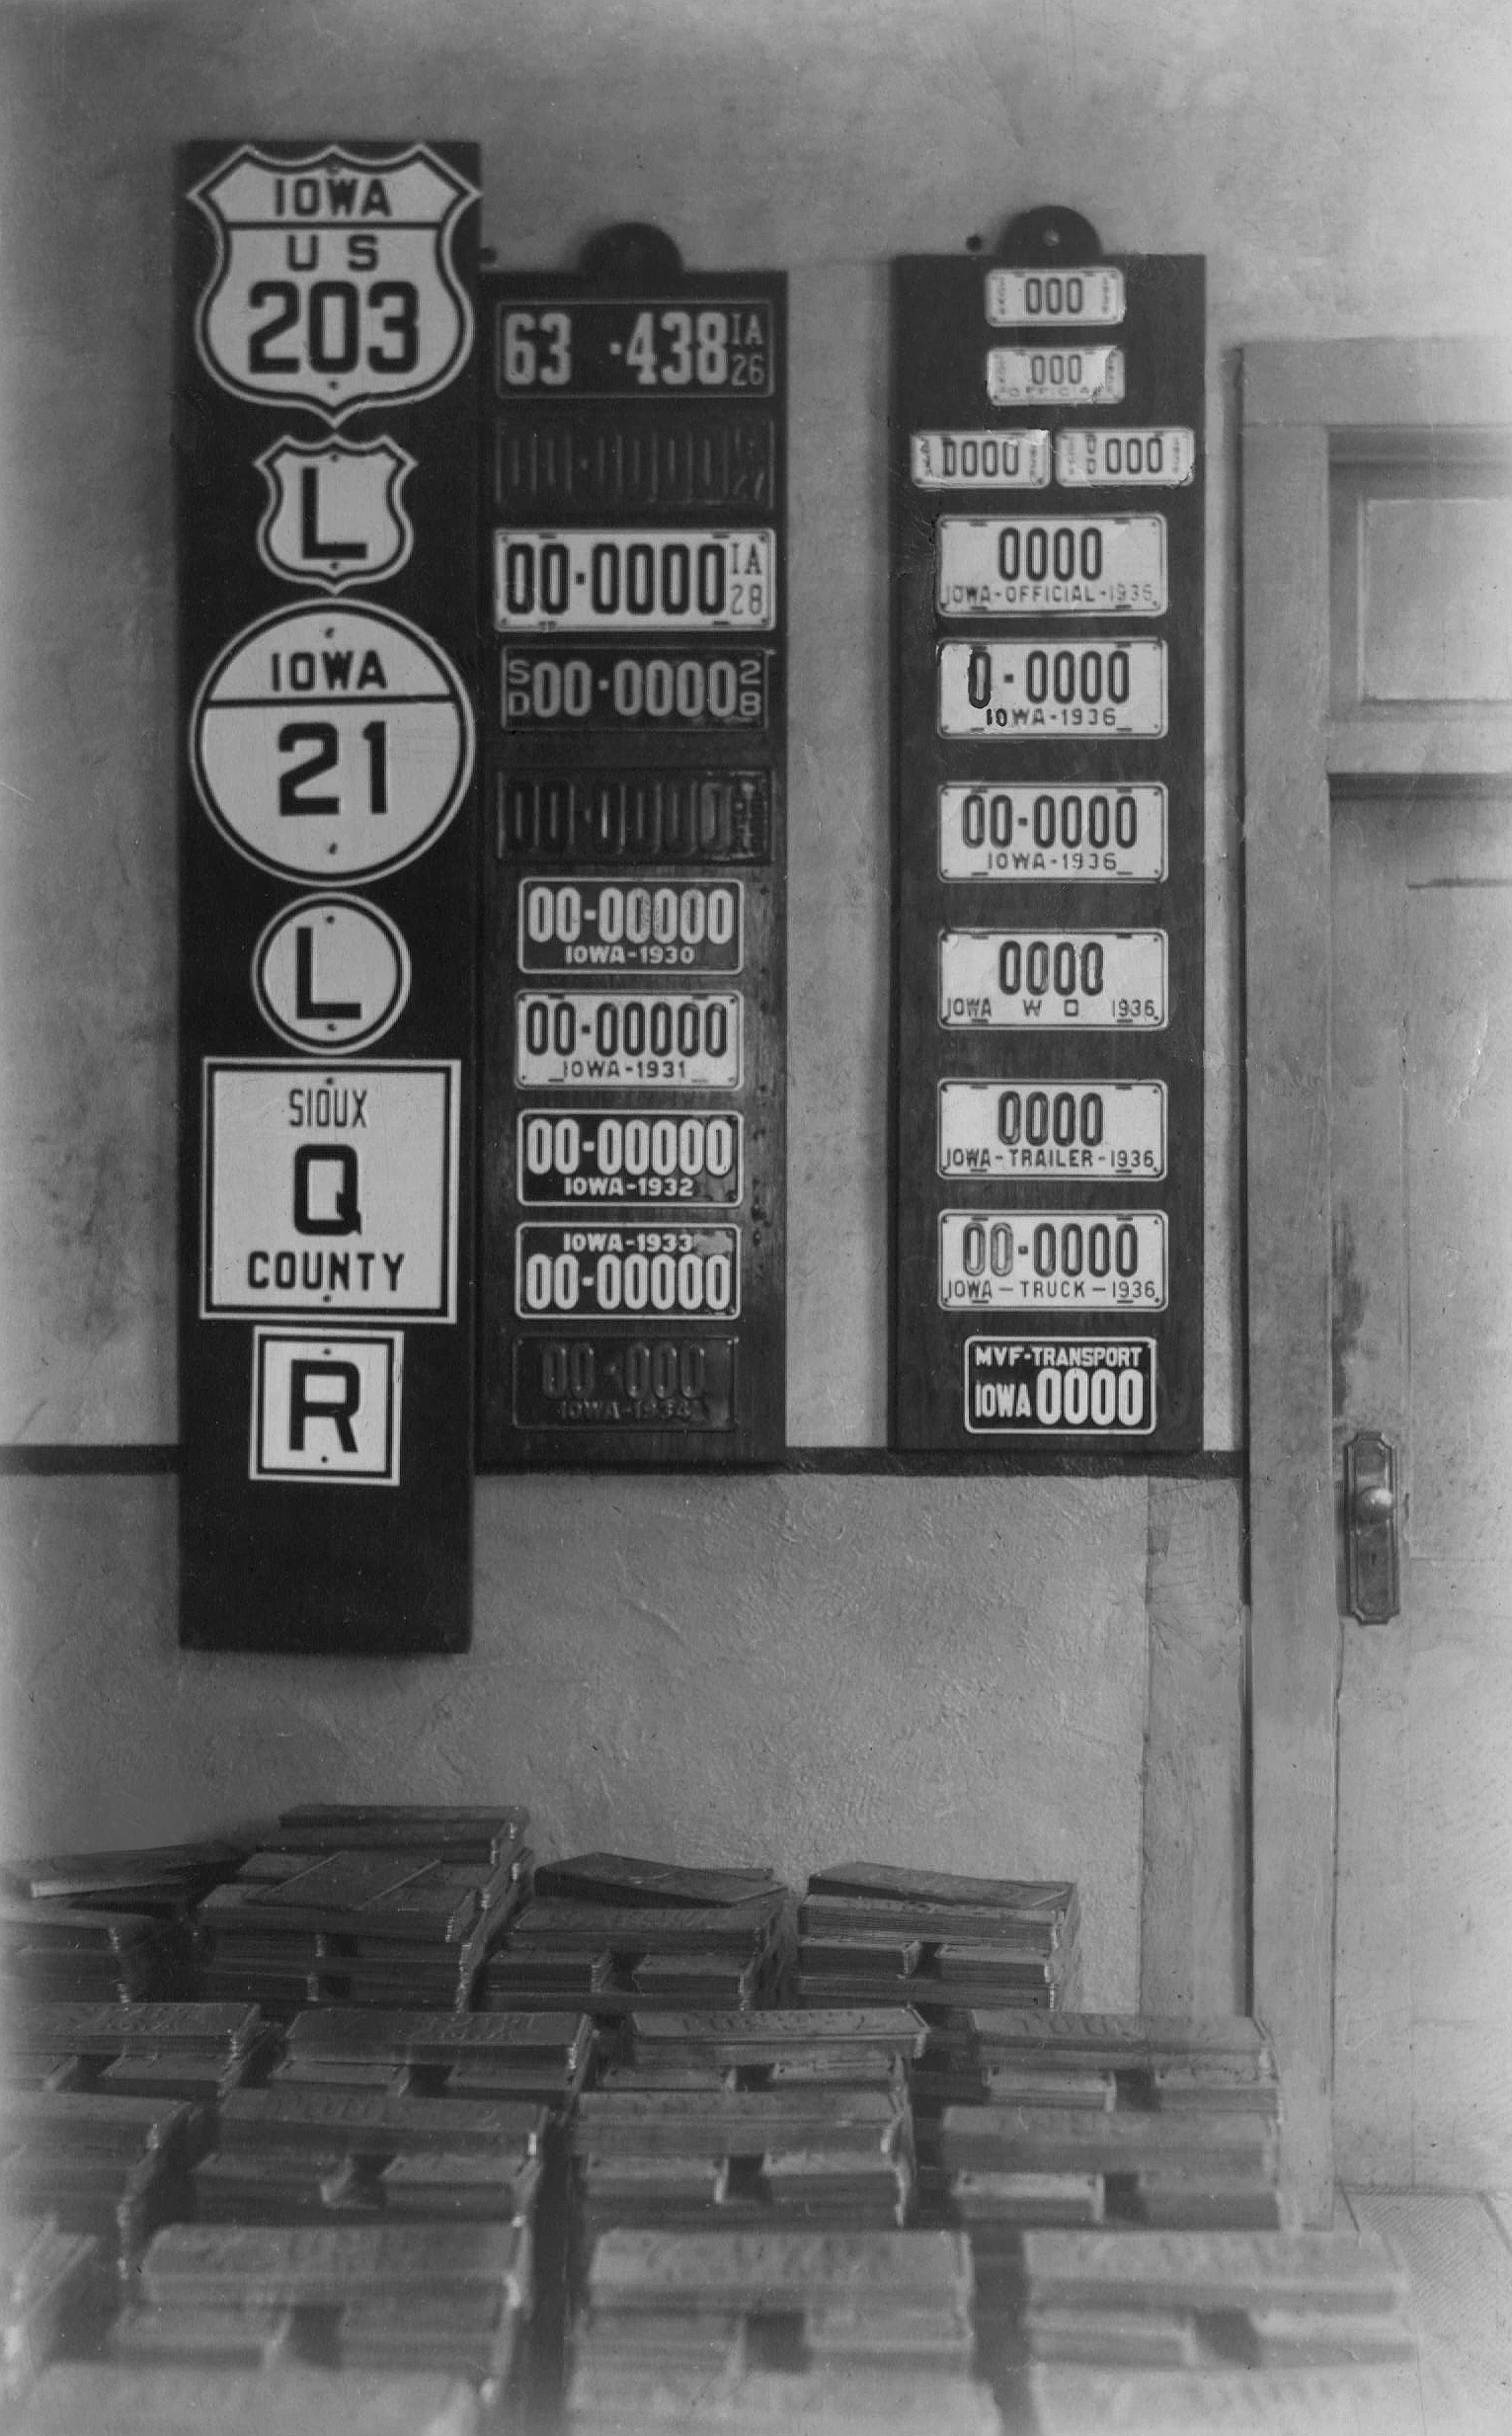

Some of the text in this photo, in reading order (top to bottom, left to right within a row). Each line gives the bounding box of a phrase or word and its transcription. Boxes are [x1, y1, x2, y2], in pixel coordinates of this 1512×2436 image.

[276, 178, 392, 217] IOWA
[288, 235, 378, 271] U S
[1025, 278, 1083, 314] 000
[249, 281, 419, 373] 203
[505, 312, 571, 385] 63
[732, 313, 764, 346] IA
[730, 354, 764, 386] 26
[1031, 355, 1082, 385] 000
[1105, 438, 1162, 474] 000
[302, 466, 367, 559] L
[732, 544, 762, 575] IA
[998, 527, 1102, 581] 0000
[731, 583, 763, 615] 28
[272, 649, 387, 691] IOWA
[279, 721, 388, 816] 21
[962, 794, 1138, 849] 00-0000
[528, 887, 734, 943] 00-00000
[296, 928, 362, 1019] L
[566, 945, 695, 964] IOWA-1930
[998, 940, 1103, 996] 0000
[526, 1002, 728, 1057] 00-00000
[947, 999, 992, 1017] IOWA
[1112, 999, 1155, 1017] 1936
[563, 1061, 686, 1079] IOWA-1931
[288, 1089, 368, 1128] SIOUX
[997, 1091, 1103, 1147] 0000
[527, 1118, 732, 1176] 00-00000
[294, 1144, 361, 1236] Q
[564, 1177, 694, 1197] IOWA-1932
[248, 1251, 404, 1291] COUNTY
[962, 1223, 1139, 1278] 00-0000
[526, 1254, 731, 1311] 00-00000
[289, 1358, 359, 1453] R
[975, 1368, 1144, 1425] IOWA 0000
